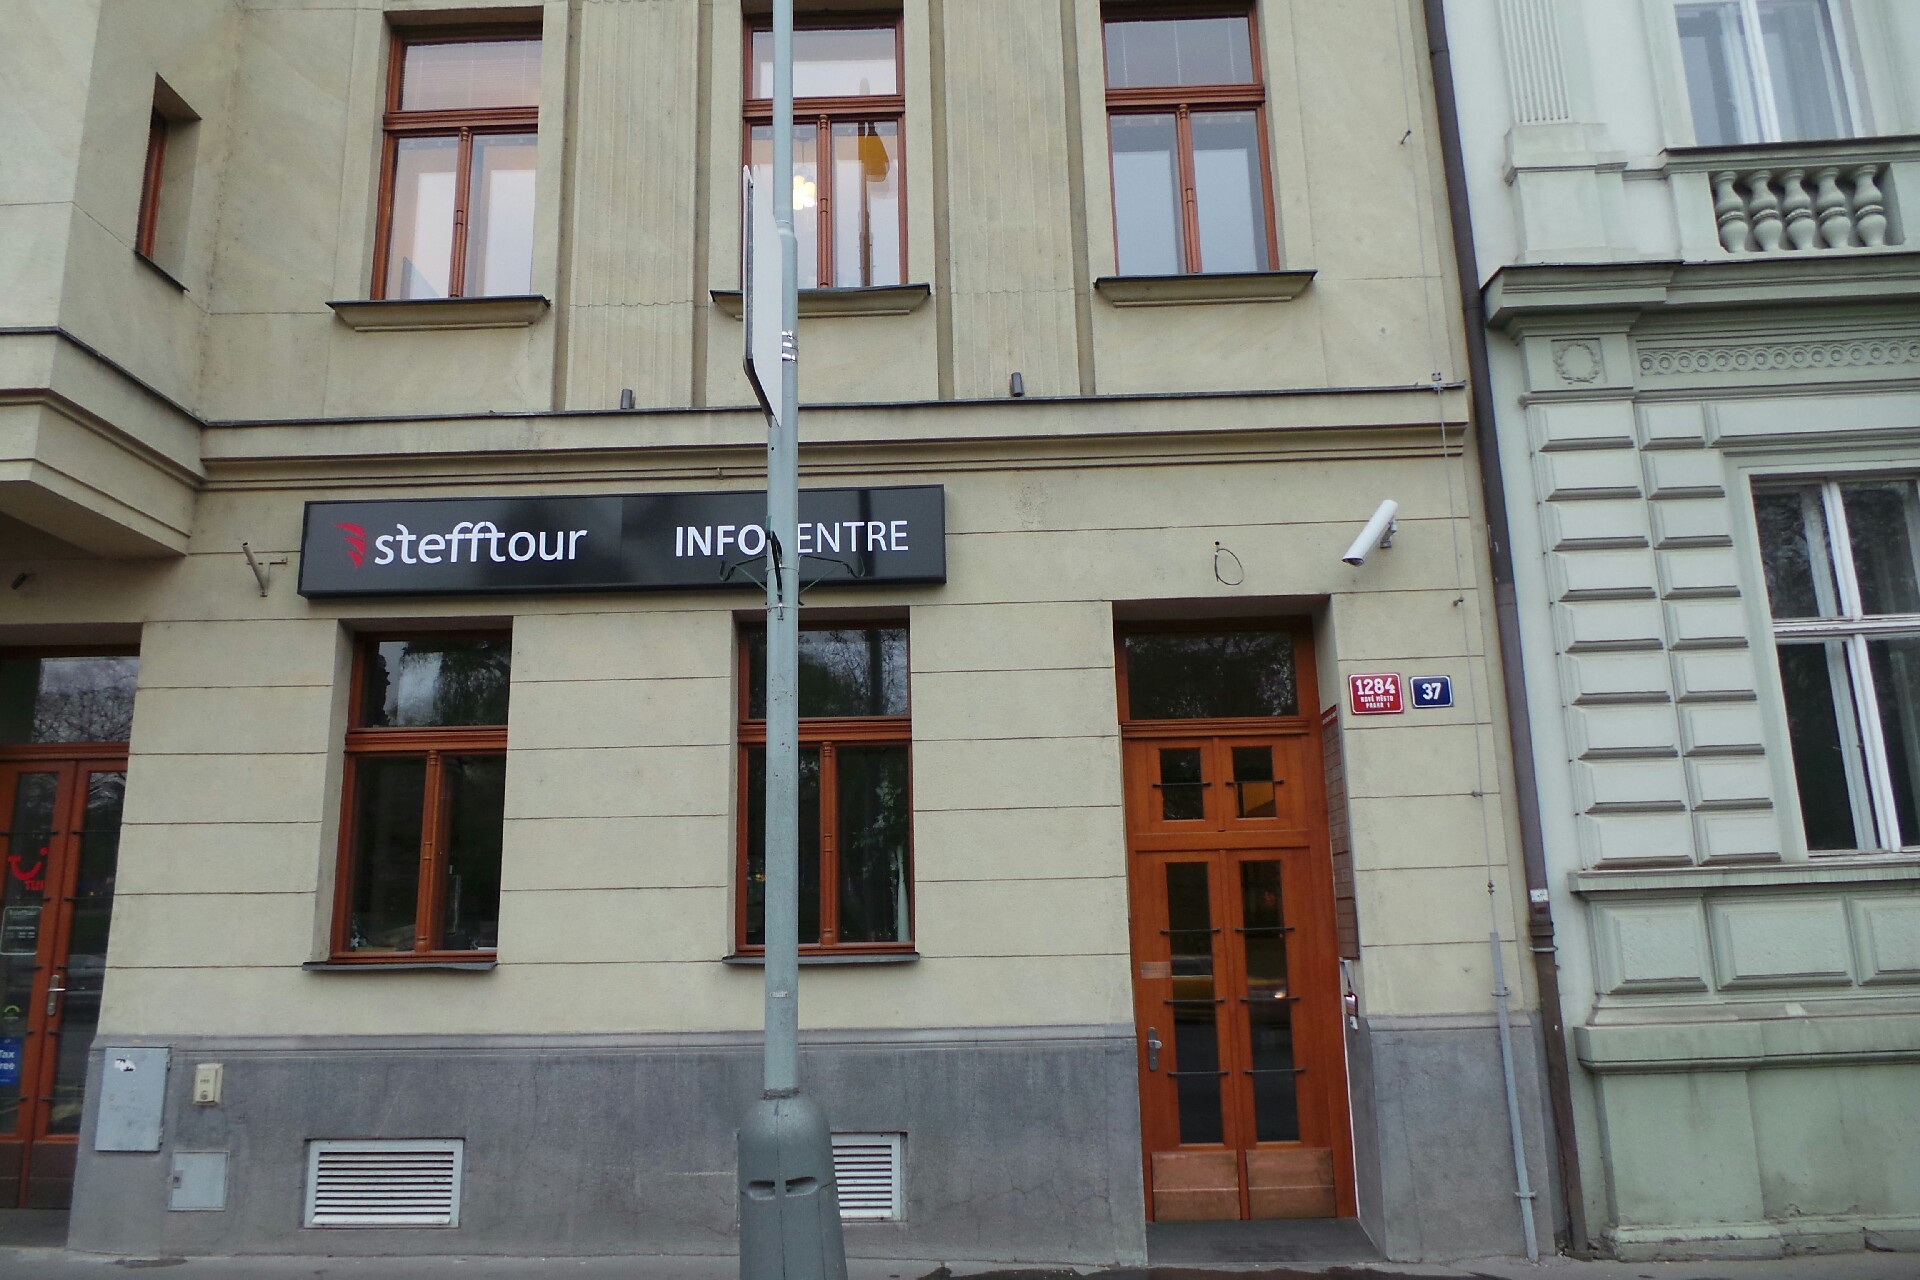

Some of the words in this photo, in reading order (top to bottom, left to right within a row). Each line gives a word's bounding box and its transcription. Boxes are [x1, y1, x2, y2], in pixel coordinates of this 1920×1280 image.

[373, 520, 589, 565] stefftour
[1356, 678, 1396, 695] 1284
[1422, 682, 1442, 700] 37
